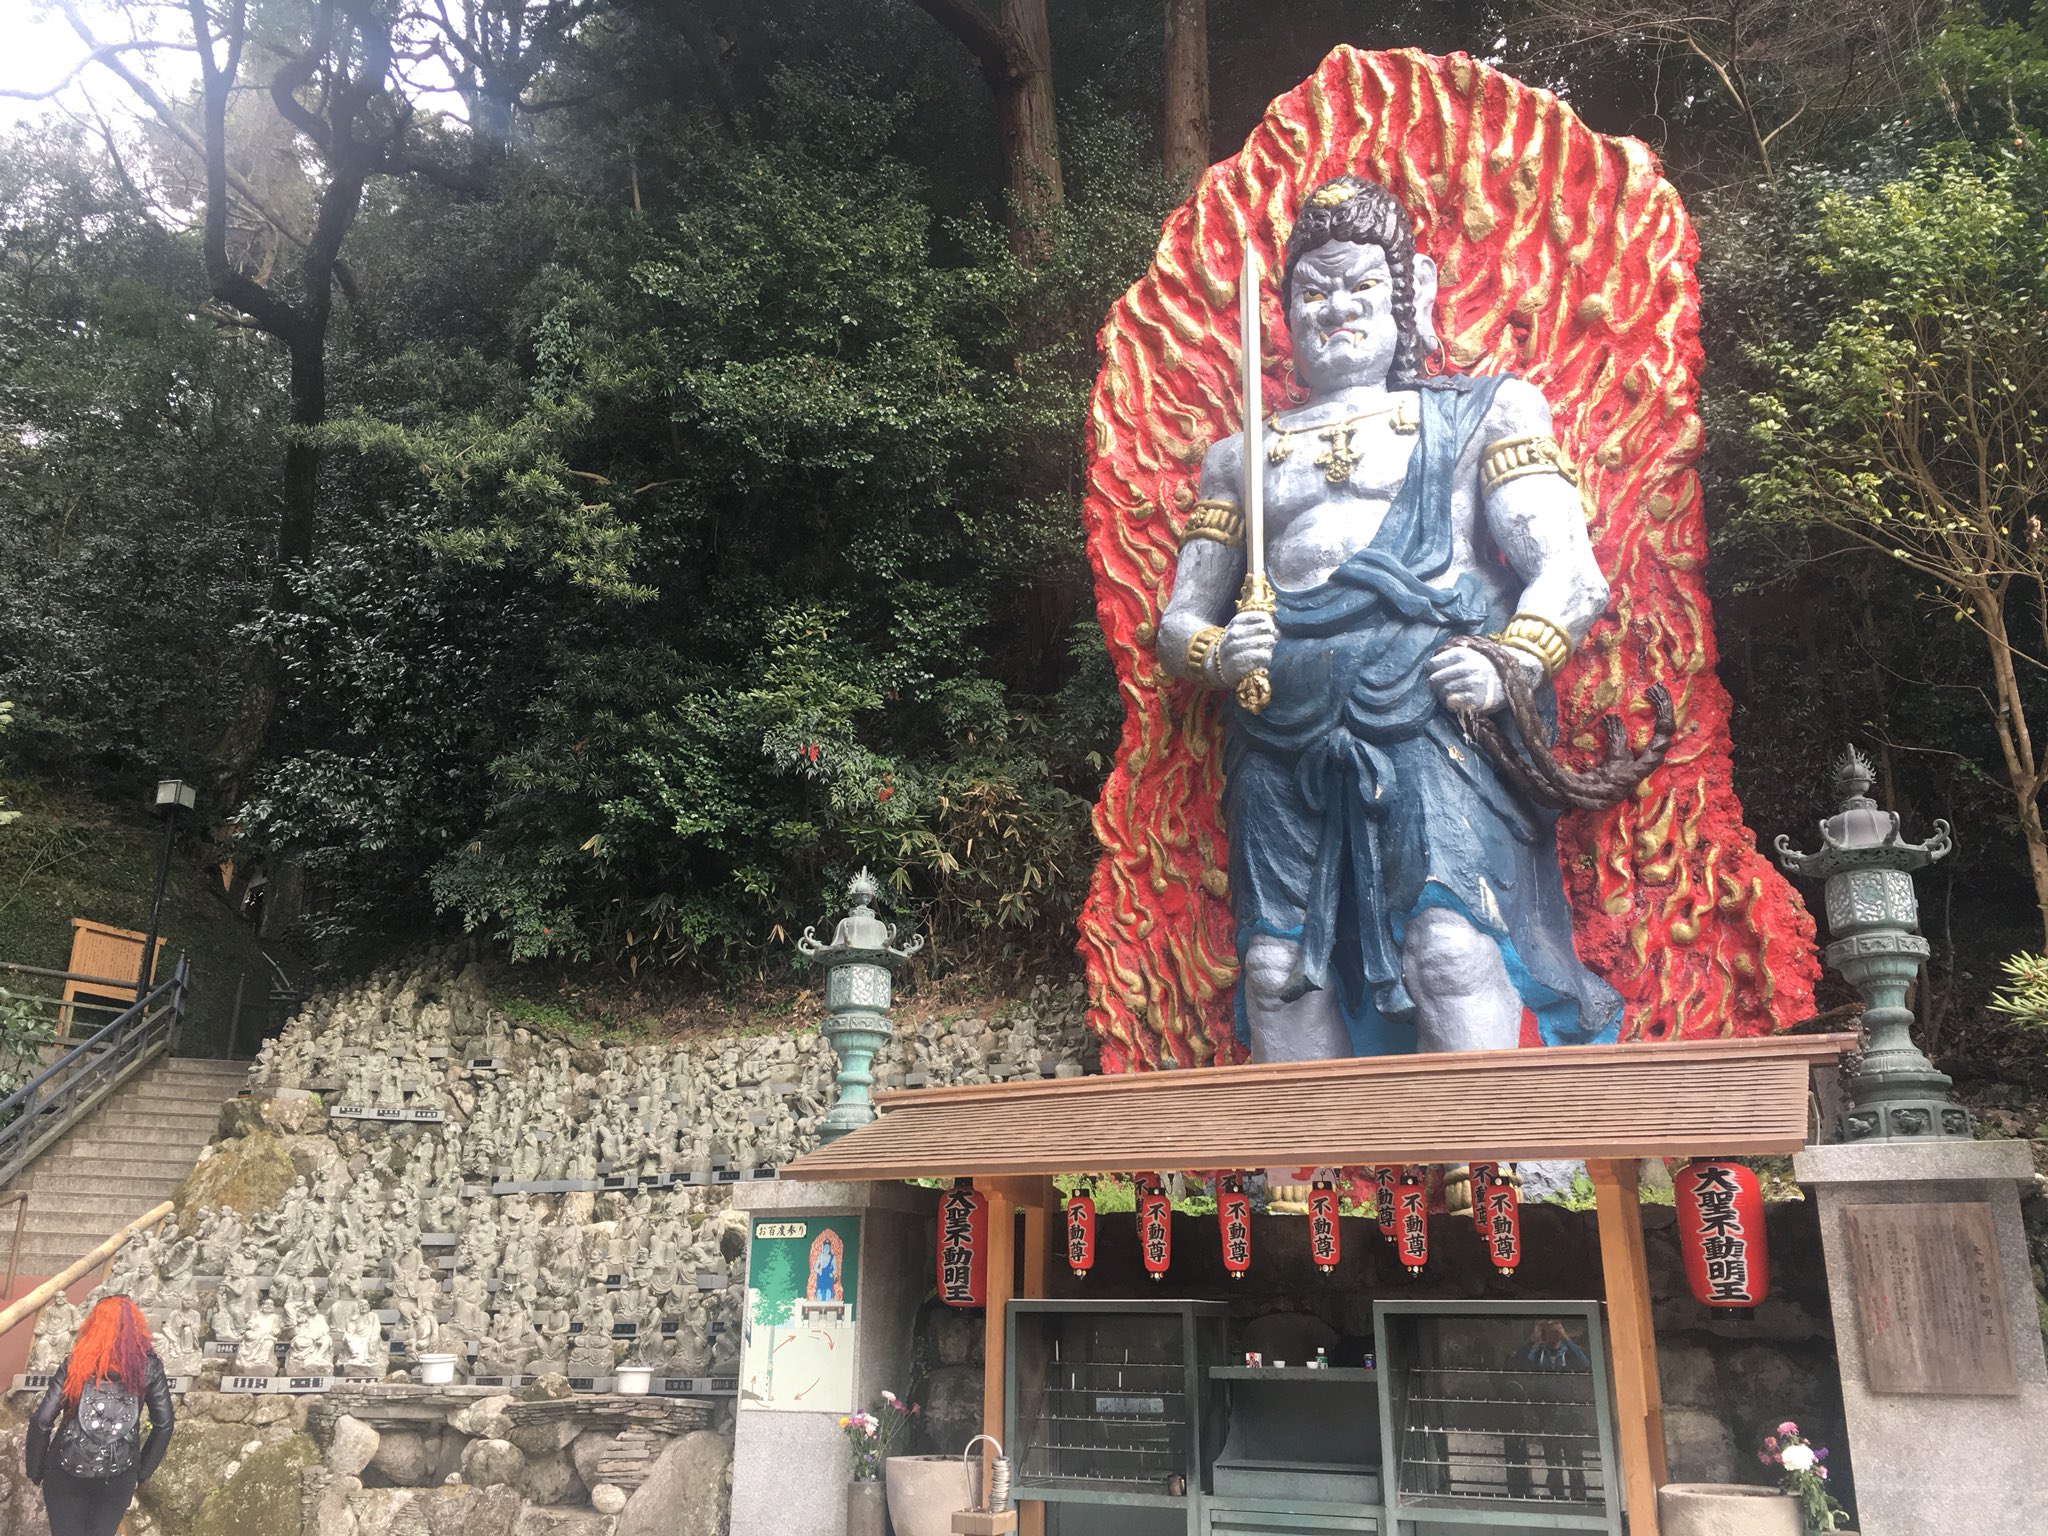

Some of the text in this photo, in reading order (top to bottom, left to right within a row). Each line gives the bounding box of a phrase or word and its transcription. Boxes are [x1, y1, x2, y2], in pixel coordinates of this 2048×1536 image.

[1311, 1197, 1335, 1257] 不動尊
[1376, 1168, 1396, 1227] 不動尊
[1402, 1194, 1427, 1257] 不動尊
[1490, 1194, 1516, 1259] 不動尊
[759, 1225, 804, 1237] お百度参り
[943, 1190, 976, 1302] 大聖不動明王
[1069, 1205, 1087, 1261] 不動尊
[1146, 1202, 1167, 1262] 不動尊
[1227, 1201, 1248, 1262] 不動尊
[1694, 1167, 1750, 1301] 大聖不動明王
